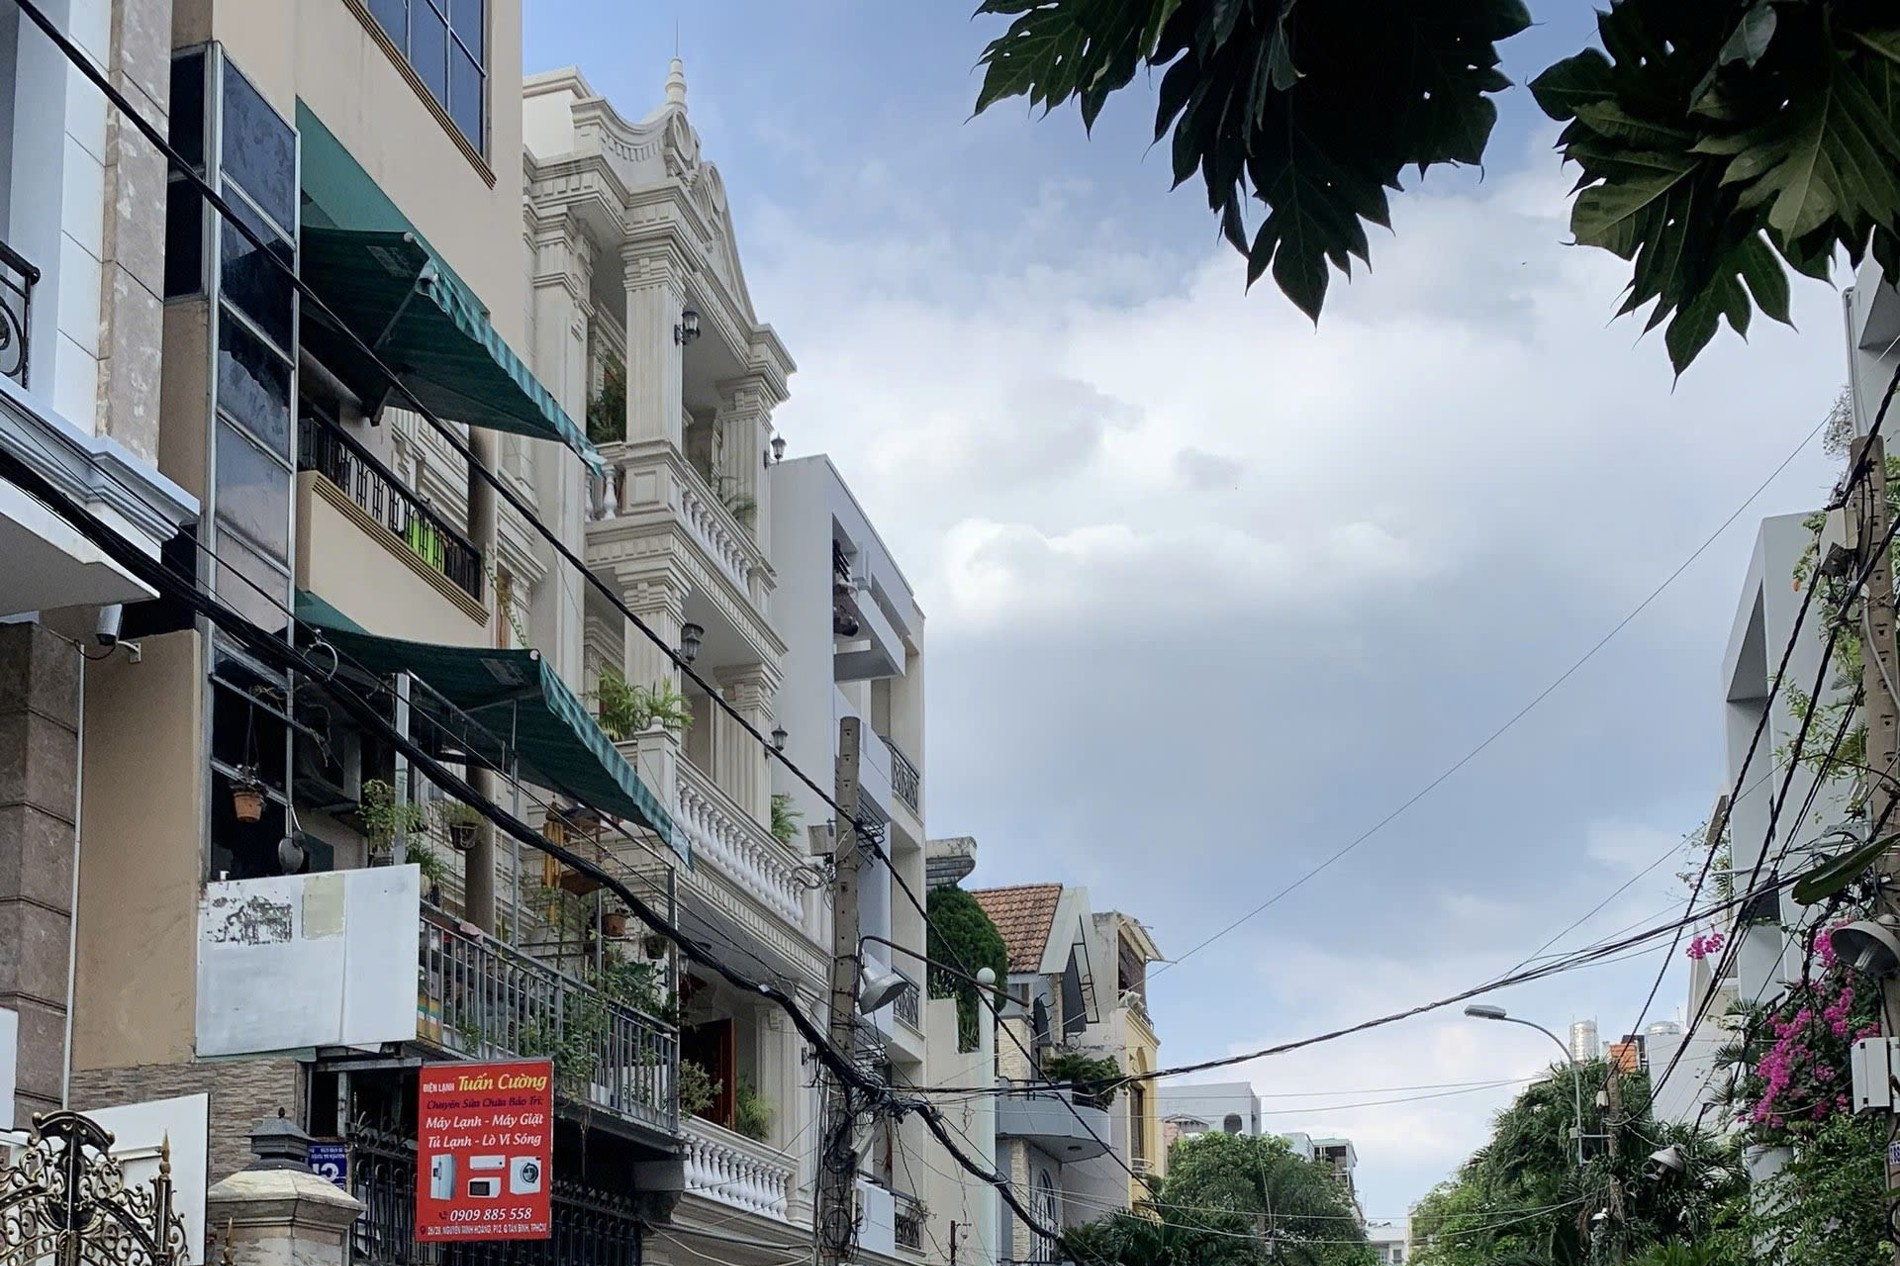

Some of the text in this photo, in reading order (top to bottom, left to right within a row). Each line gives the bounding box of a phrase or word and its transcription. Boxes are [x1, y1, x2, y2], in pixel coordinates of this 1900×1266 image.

[458, 1073, 548, 1092] Tuấn Cường
[425, 1115, 451, 1130] Máy
[453, 1115, 482, 1130] Lạnh
[492, 1114, 518, 1128] Máy
[519, 1112, 544, 1127] Giặt
[428, 1136, 441, 1148] Tủ
[443, 1135, 472, 1150] Lạnh
[482, 1134, 497, 1147] Lò
[513, 1133, 542, 1147] Sóng
[450, 1207, 532, 1222] 0909 885 558
